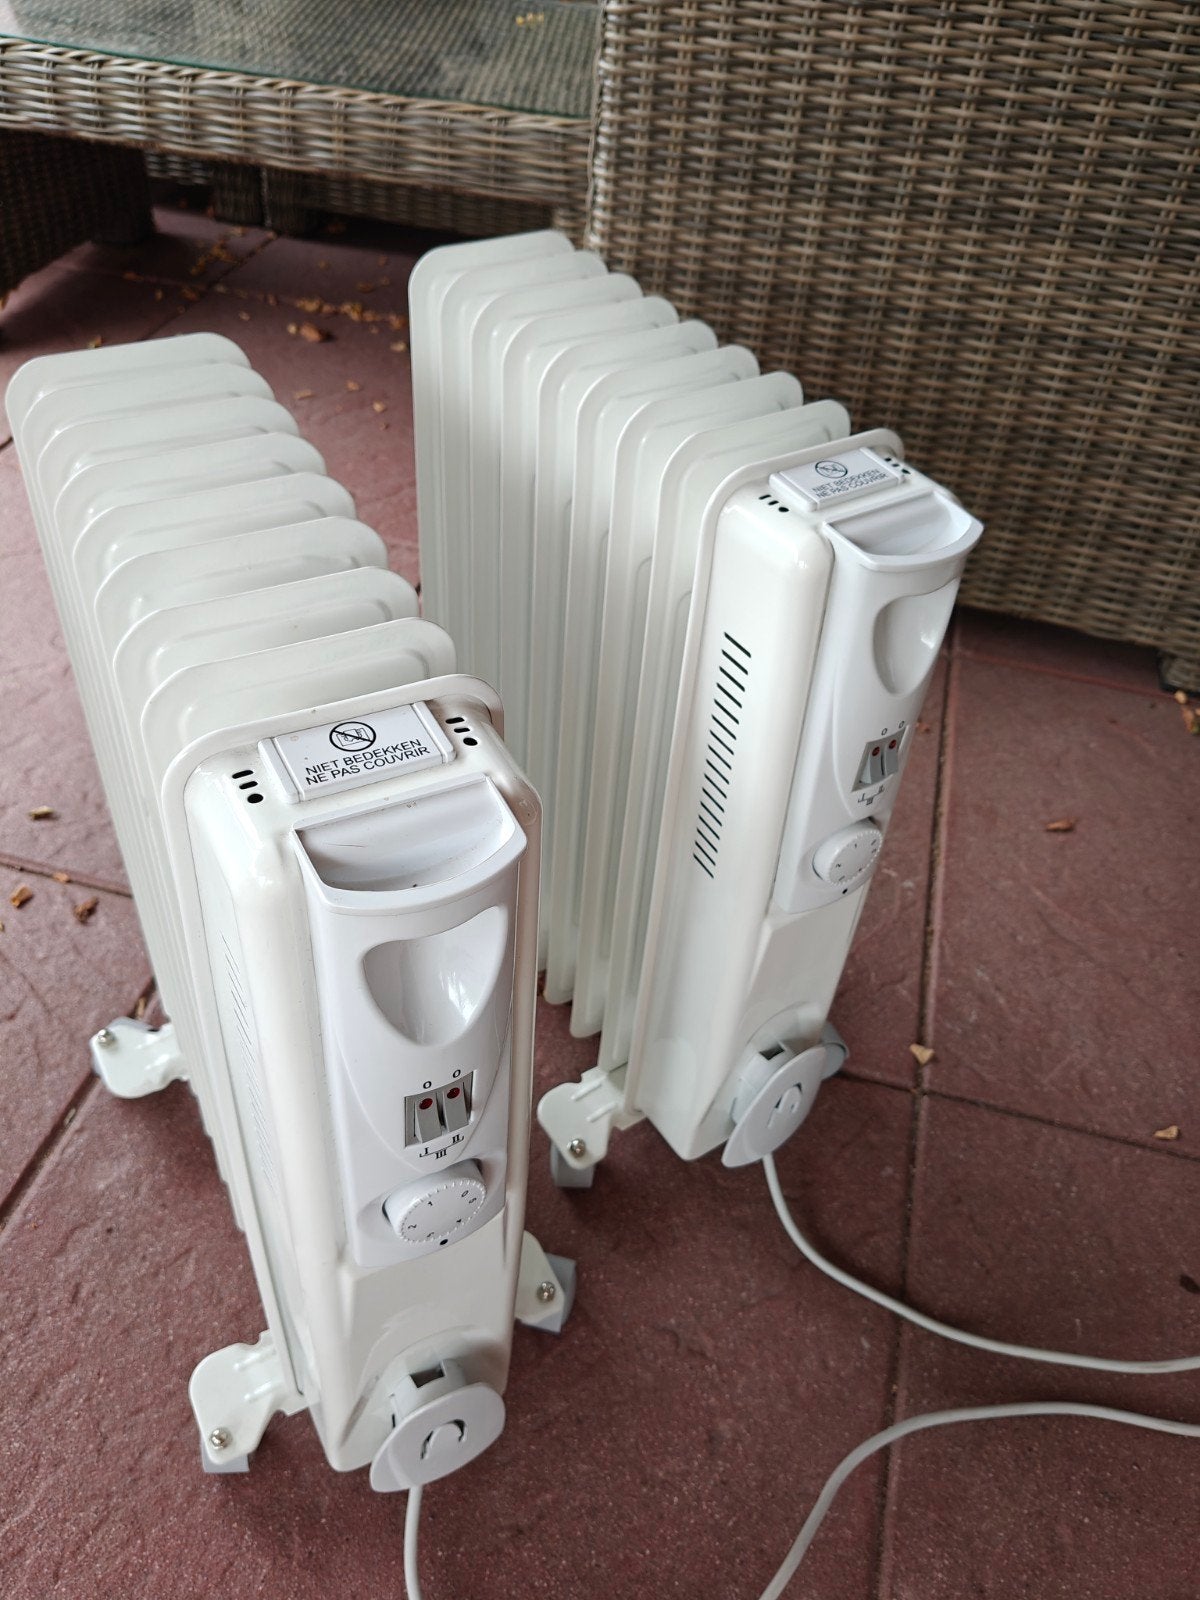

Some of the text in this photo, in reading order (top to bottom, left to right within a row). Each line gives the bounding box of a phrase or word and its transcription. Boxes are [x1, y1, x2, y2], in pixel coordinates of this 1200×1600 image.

[812, 483, 832, 493] NIET
[305, 738, 422, 775] NIET BEDEKKEN
[305, 746, 430, 785] NE PAS COUVRIR
